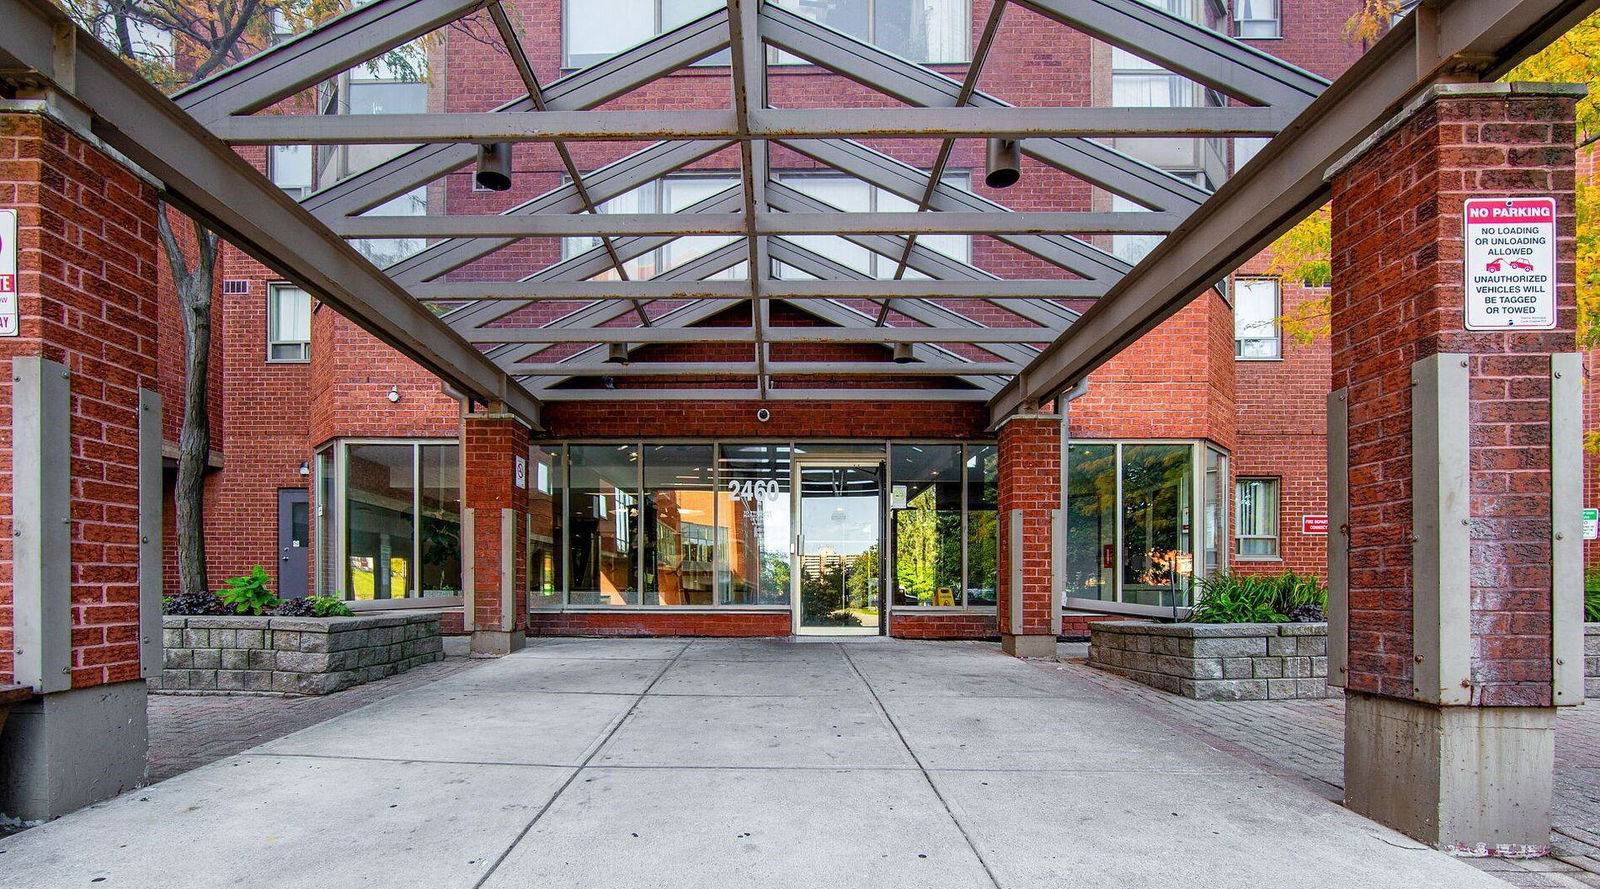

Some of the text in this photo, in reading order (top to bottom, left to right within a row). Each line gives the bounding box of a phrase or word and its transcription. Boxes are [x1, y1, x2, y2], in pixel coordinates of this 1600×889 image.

[1470, 207, 1550, 218] NO PARKING
[1481, 226, 1540, 235] NO LOADING
[1475, 237, 1546, 246] OR UNLOADING
[1487, 248, 1533, 256] ALLOWED
[1474, 275, 1547, 283] UNAUTHORIZED
[1476, 285, 1546, 294] VEHICLES WILL
[1484, 295, 1537, 304] BE TAGGED
[1486, 306, 1536, 315] OR TOWED
[728, 479, 780, 502] 2460
